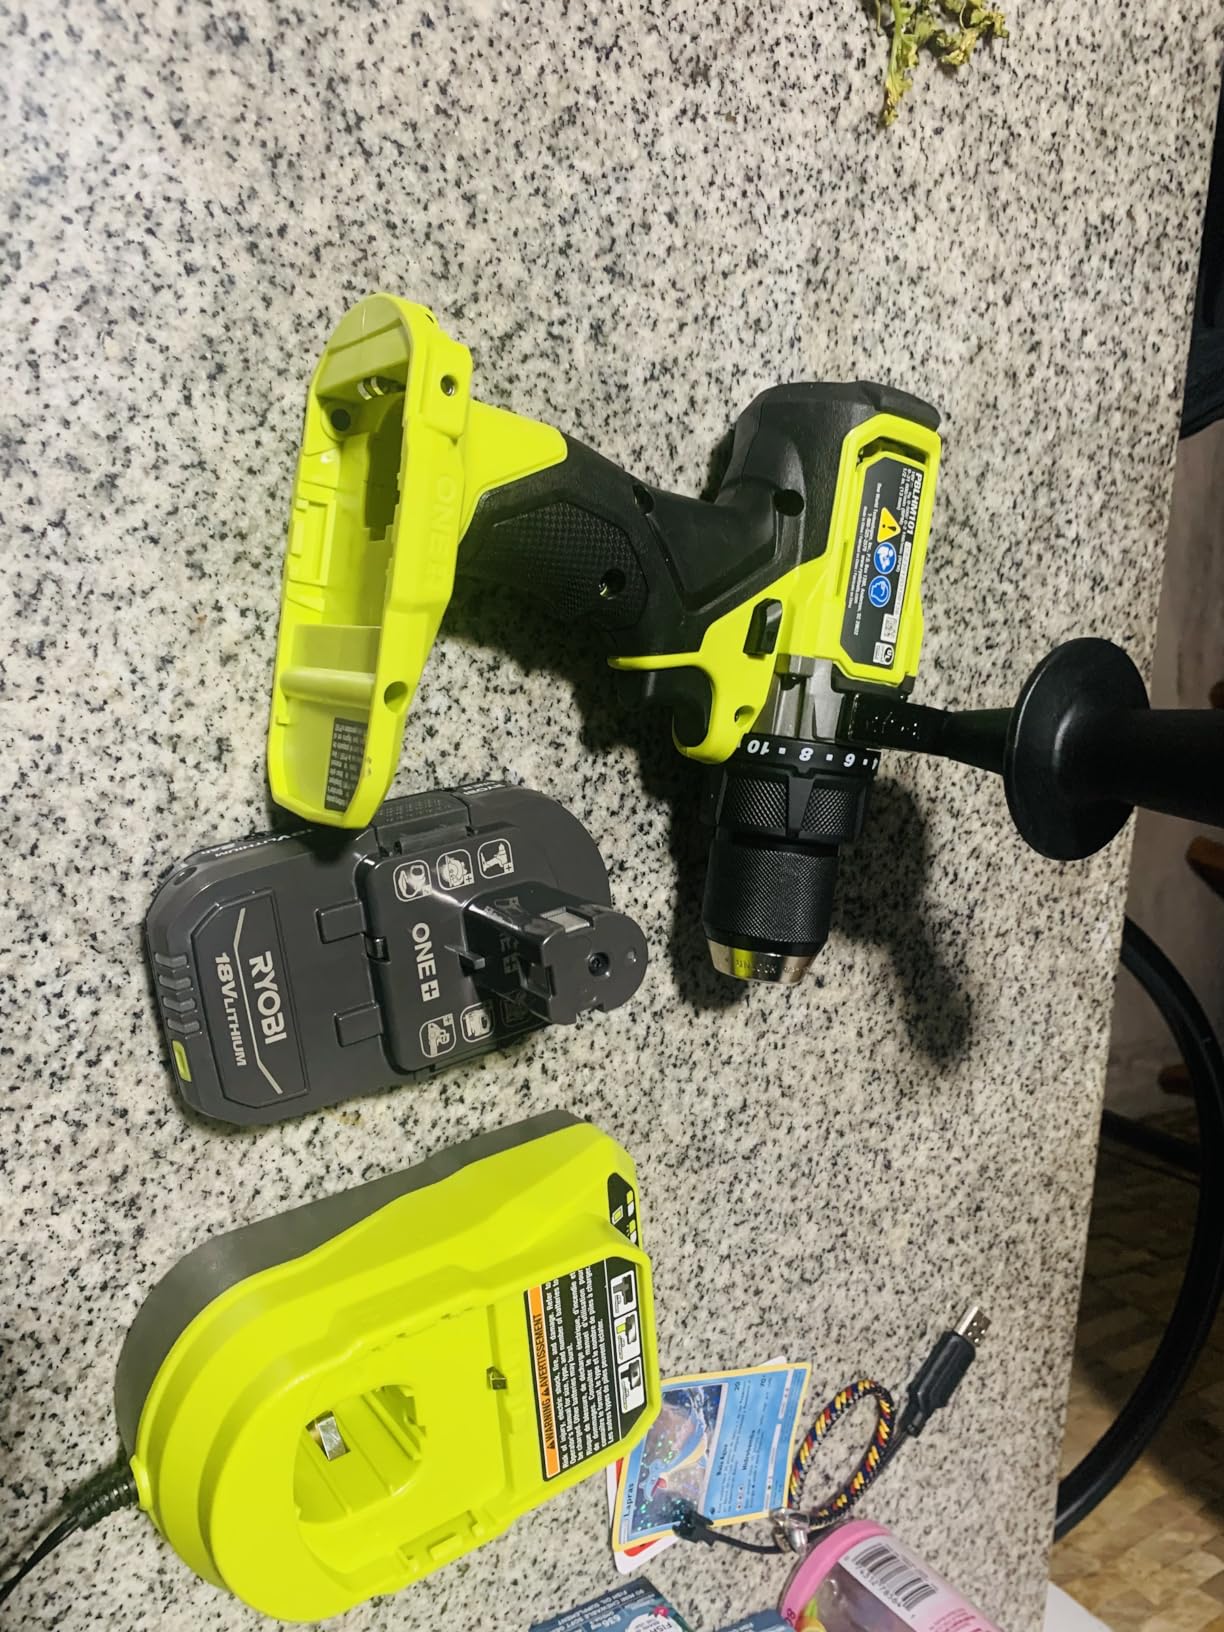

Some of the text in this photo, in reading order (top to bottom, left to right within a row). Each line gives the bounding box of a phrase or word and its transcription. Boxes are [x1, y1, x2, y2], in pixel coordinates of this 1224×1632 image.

[906, 472, 922, 535] PBLHM101
[747, 739, 769, 755] 10
[799, 747, 814, 761] 8
[843, 753, 855, 767] 6
[249, 951, 287, 1044] RYOBI
[545, 1290, 553, 1311] Refer
[552, 1285, 562, 1317] batteries
[569, 1279, 579, 1316] d'incendie
[578, 1287, 588, 1329] d'utilisation
[587, 1297, 595, 1315] piles
[547, 1310, 557, 1341] damage.
[556, 1316, 562, 1325] of
[588, 1314, 595, 1325] de
[596, 1317, 605, 1343] éclater.
[556, 1324, 565, 1351] number
[572, 1314, 584, 1351] électrique,
[582, 1329, 590, 1356] manuel
[589, 1323, 598, 1350] nombre
[550, 1341, 558, 1356] and
[591, 1349, 598, 1358] le
[598, 1341, 608, 1369] peuvent
[551, 1356, 559, 1372] fire,
[560, 1362, 568, 1381] type,
[575, 1350, 587, 1383] décharge
[584, 1357, 591, 1367] le
[592, 1356, 599, 1366] et
[593, 1363, 601, 1380] type
[531, 1311, 554, 1442] WARNING AVERTISSEMENT
[553, 1371, 562, 1395] shock,
[585, 1367, 595, 1401] Consulter
[594, 1378, 601, 1388] le
[601, 1366, 609, 1385] piles
[561, 1379, 570, 1397] size,
[579, 1381, 586, 1393] de
[595, 1385, 604, 1411] format,
[602, 1382, 609, 1394] de
[555, 1395, 564, 1422] electric
[566, 1342, 583, 1461] be charged. Other batteries may burst.
[580, 1391, 590, 1423] blessure,
[603, 1391, 612, 1411] types
[564, 1406, 573, 1432] Manual
[589, 1400, 599, 1440] dommages.
[597, 1409, 604, 1418] le
[558, 1420, 567, 1443] injury,
[583, 1422, 590, 1433] de
[560, 1443, 567, 1452] of
[566, 1430, 577, 1465] Operator's
[583, 1431, 593, 1456] Risque
[593, 1441, 599, 1452] de
[561, 1452, 569, 1469] Risk
[623, 1483, 634, 1517] Lapras
[557, 1602, 601, 1626] SUPPLEMENT
[583, 1600, 621, 1620] CHEWABLE
[600, 1614, 621, 1628] 636
